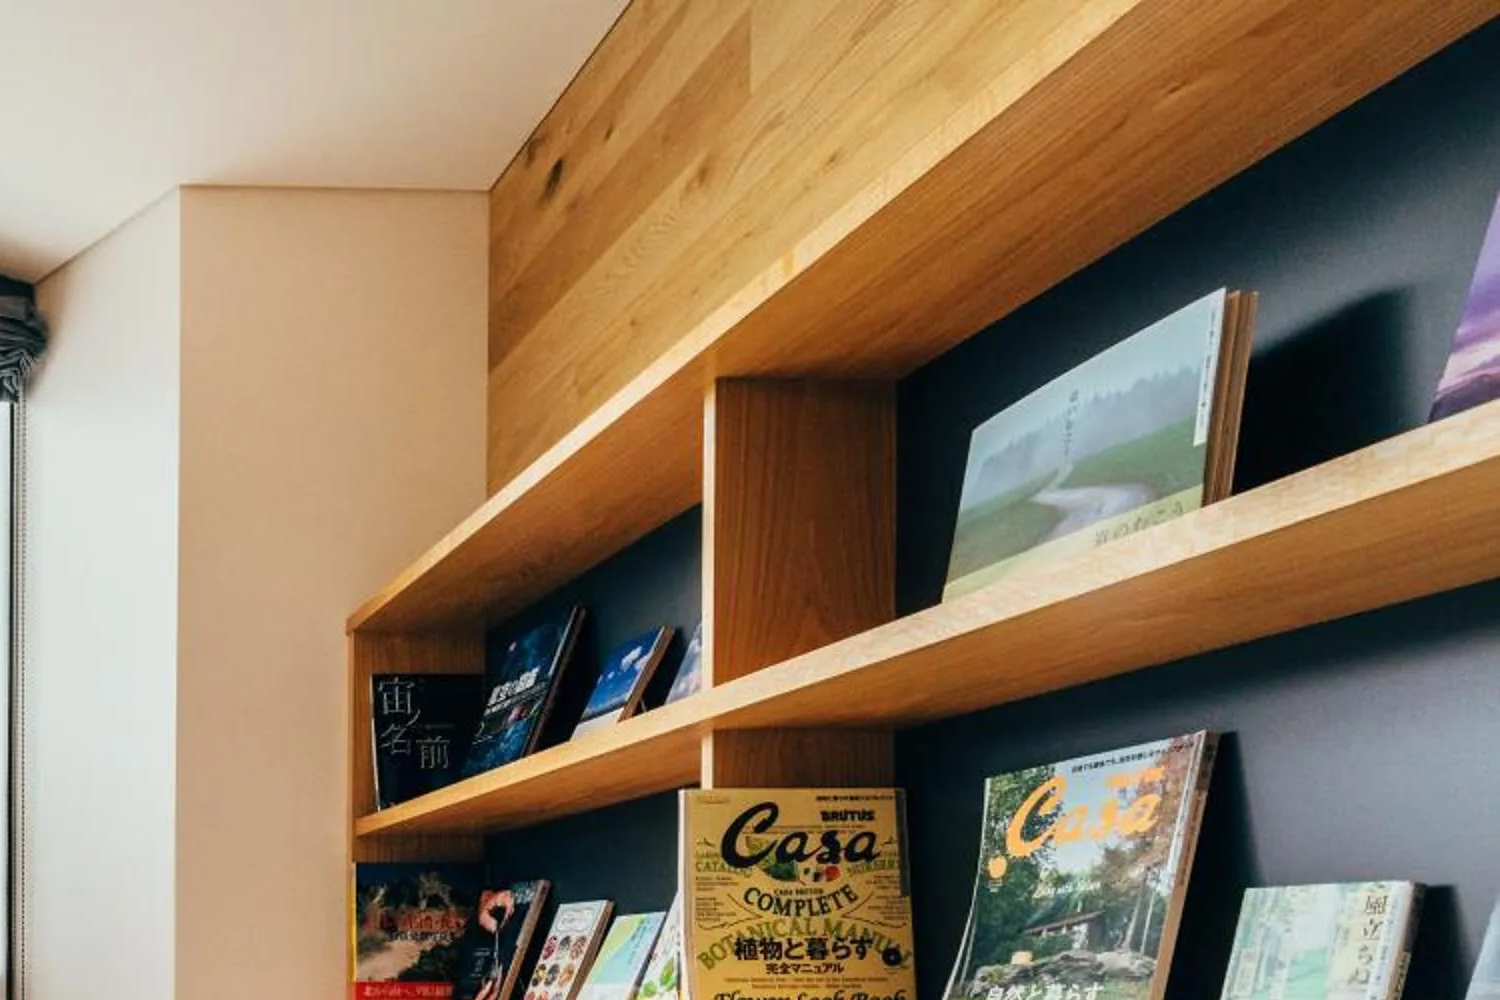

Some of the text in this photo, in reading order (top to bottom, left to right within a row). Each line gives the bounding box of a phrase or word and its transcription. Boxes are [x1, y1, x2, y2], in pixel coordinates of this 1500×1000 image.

[721, 801, 882, 868] Casa
[743, 887, 859, 918] COMPLETE
[733, 936, 874, 961] 植物と暮らす
[765, 962, 845, 975] 完全マニュアル
